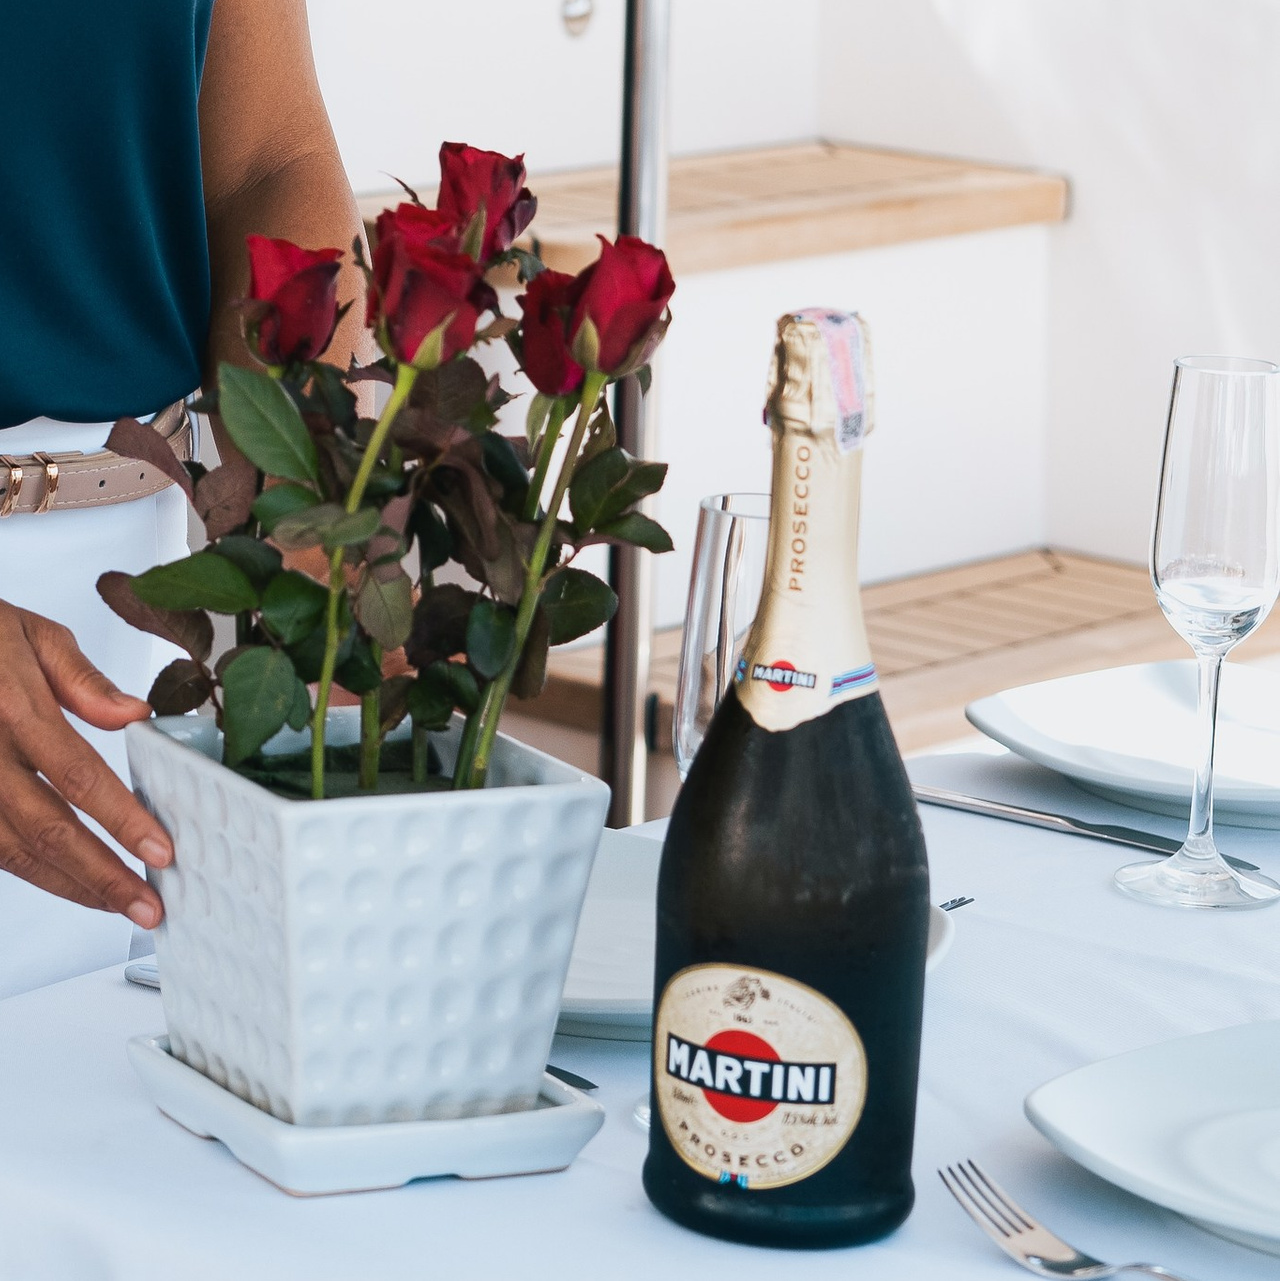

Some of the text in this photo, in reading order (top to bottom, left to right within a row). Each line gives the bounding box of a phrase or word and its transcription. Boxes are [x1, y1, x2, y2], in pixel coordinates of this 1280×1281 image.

[788, 446, 812, 592] PROSECCO
[753, 665, 816, 688] MARTINI
[668, 1037, 832, 1102] MARTINI
[677, 1119, 806, 1169] PROSECCO
